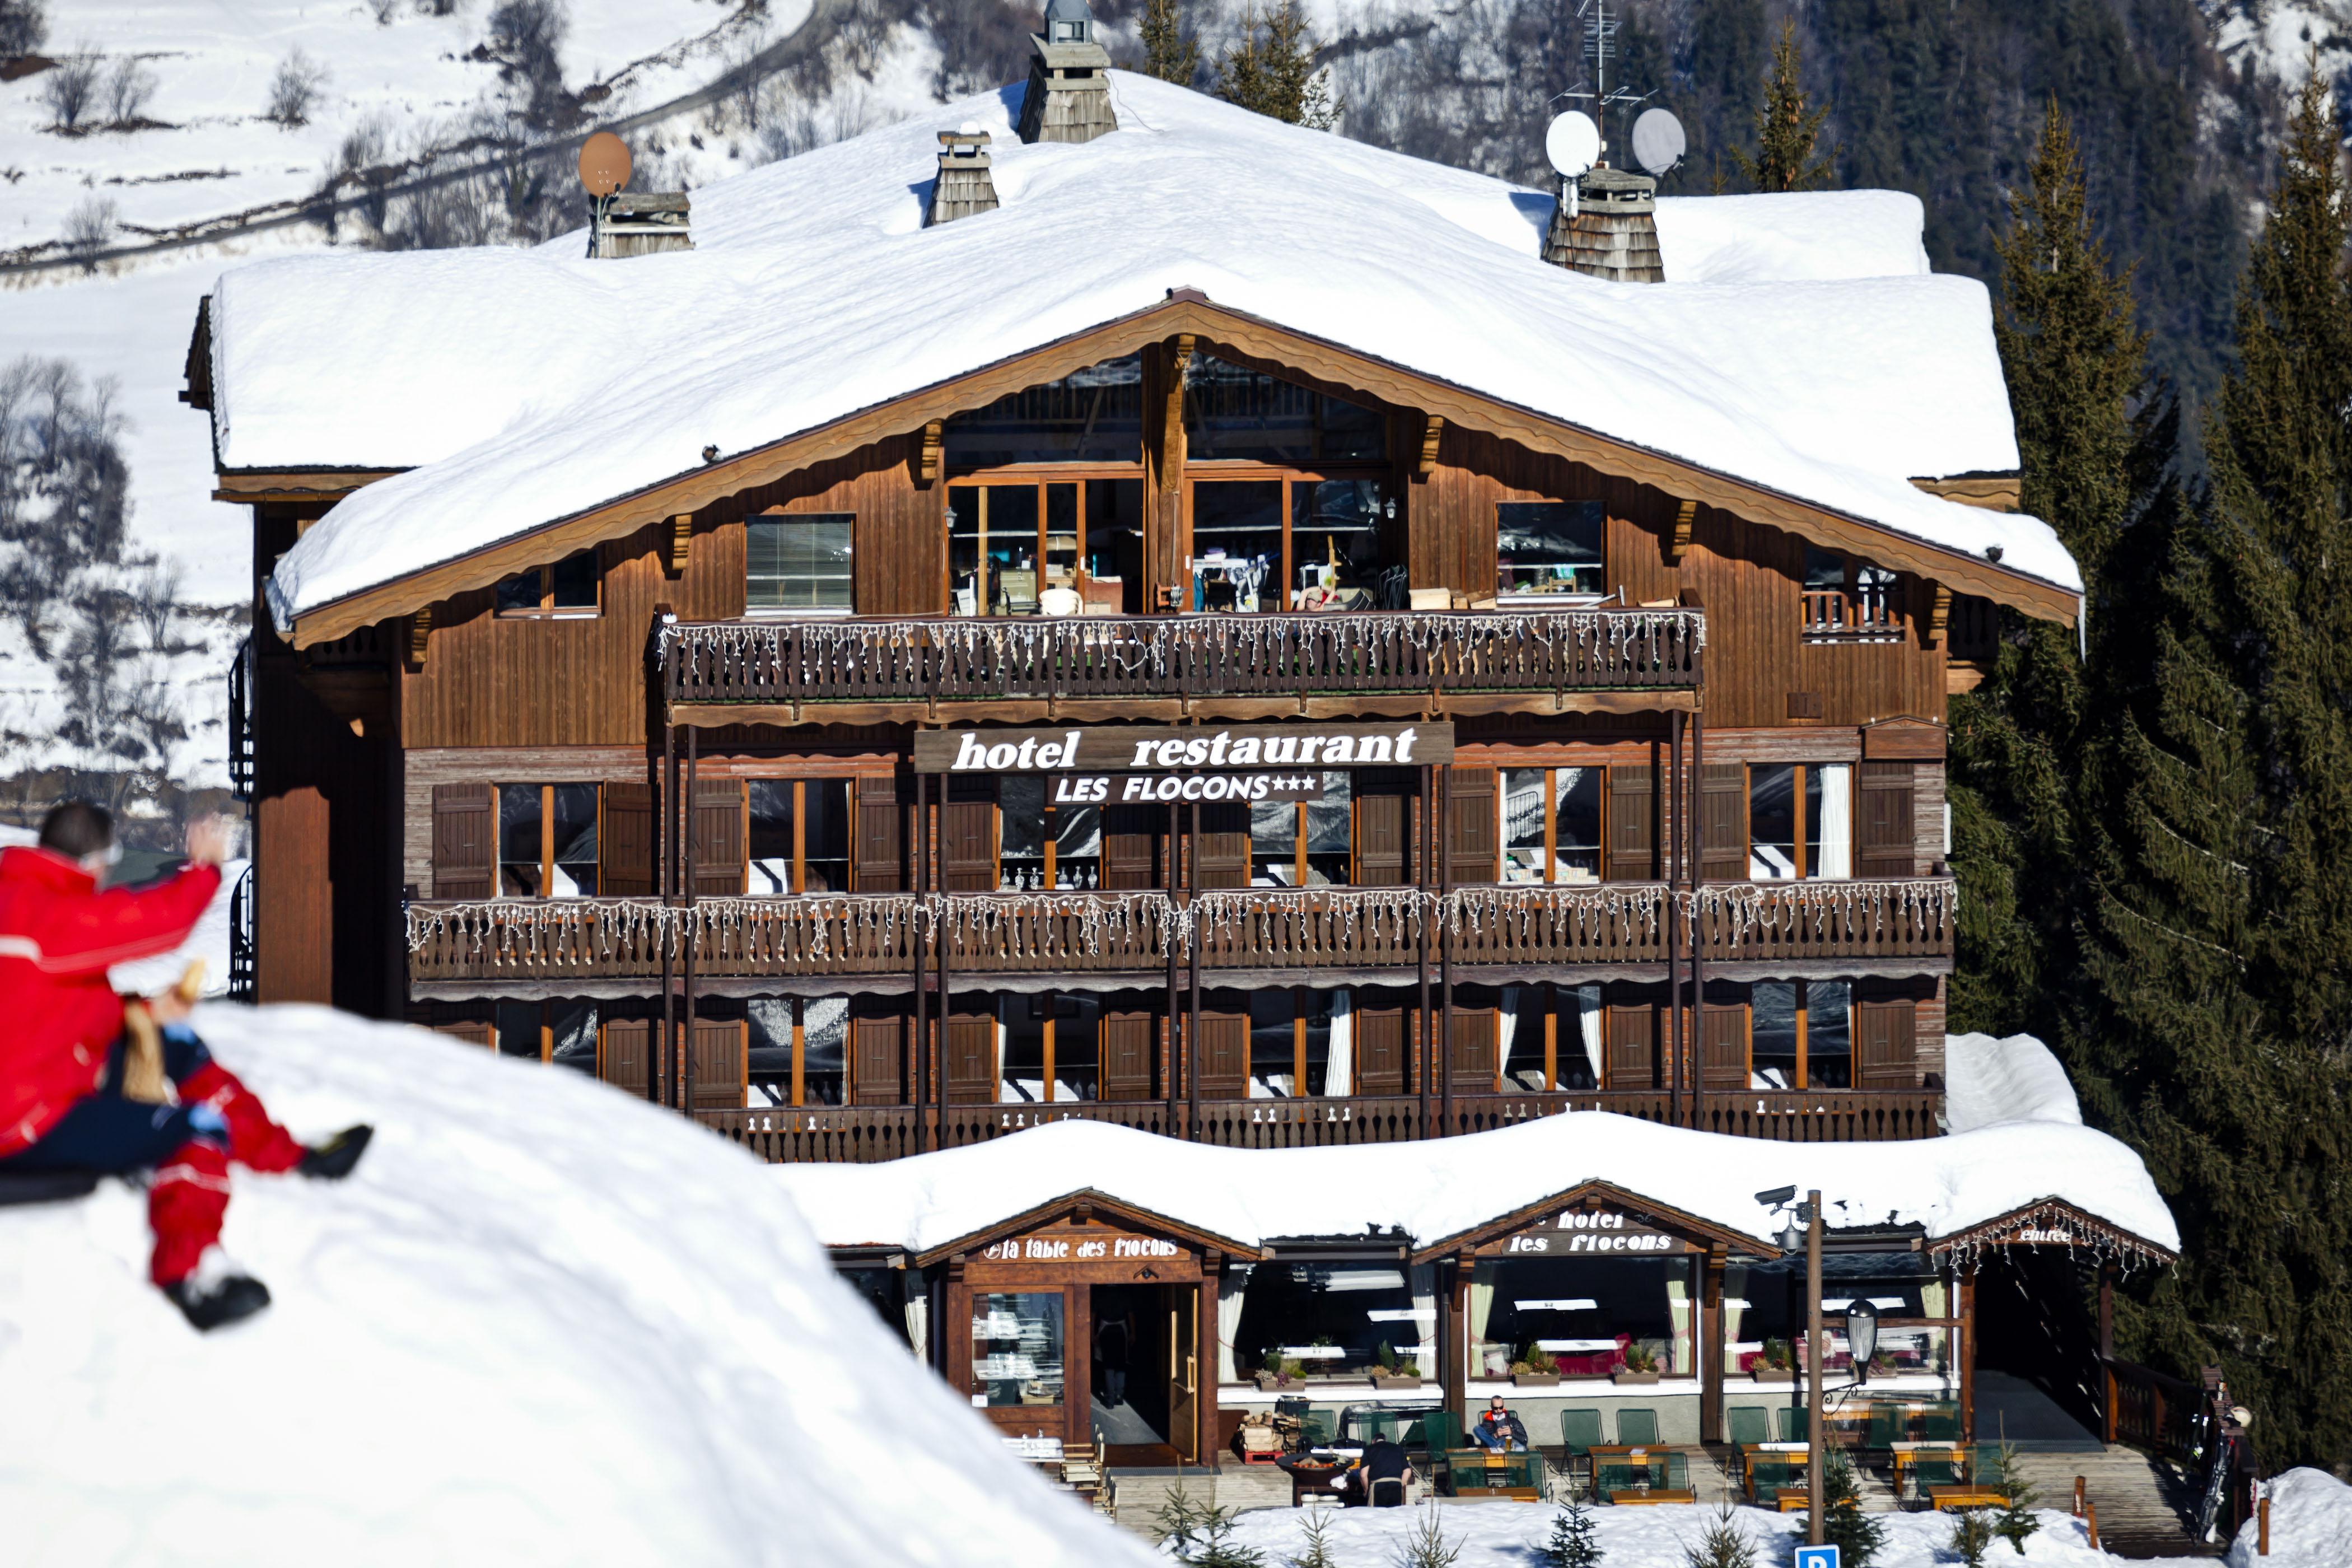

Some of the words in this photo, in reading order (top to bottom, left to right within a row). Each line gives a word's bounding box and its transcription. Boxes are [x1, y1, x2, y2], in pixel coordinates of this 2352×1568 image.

[951, 731, 1081, 770] hotel
[1130, 727, 1418, 766] restaurant
[1055, 777, 1109, 802] LES
[1122, 775, 1270, 801] FLOCONS
[1557, 1210, 1623, 1229] hotel
[1001, 1239, 1019, 1259] la
[1025, 1238, 1069, 1258] table
[1076, 1240, 1107, 1258] des
[1509, 1235, 1548, 1252] les
